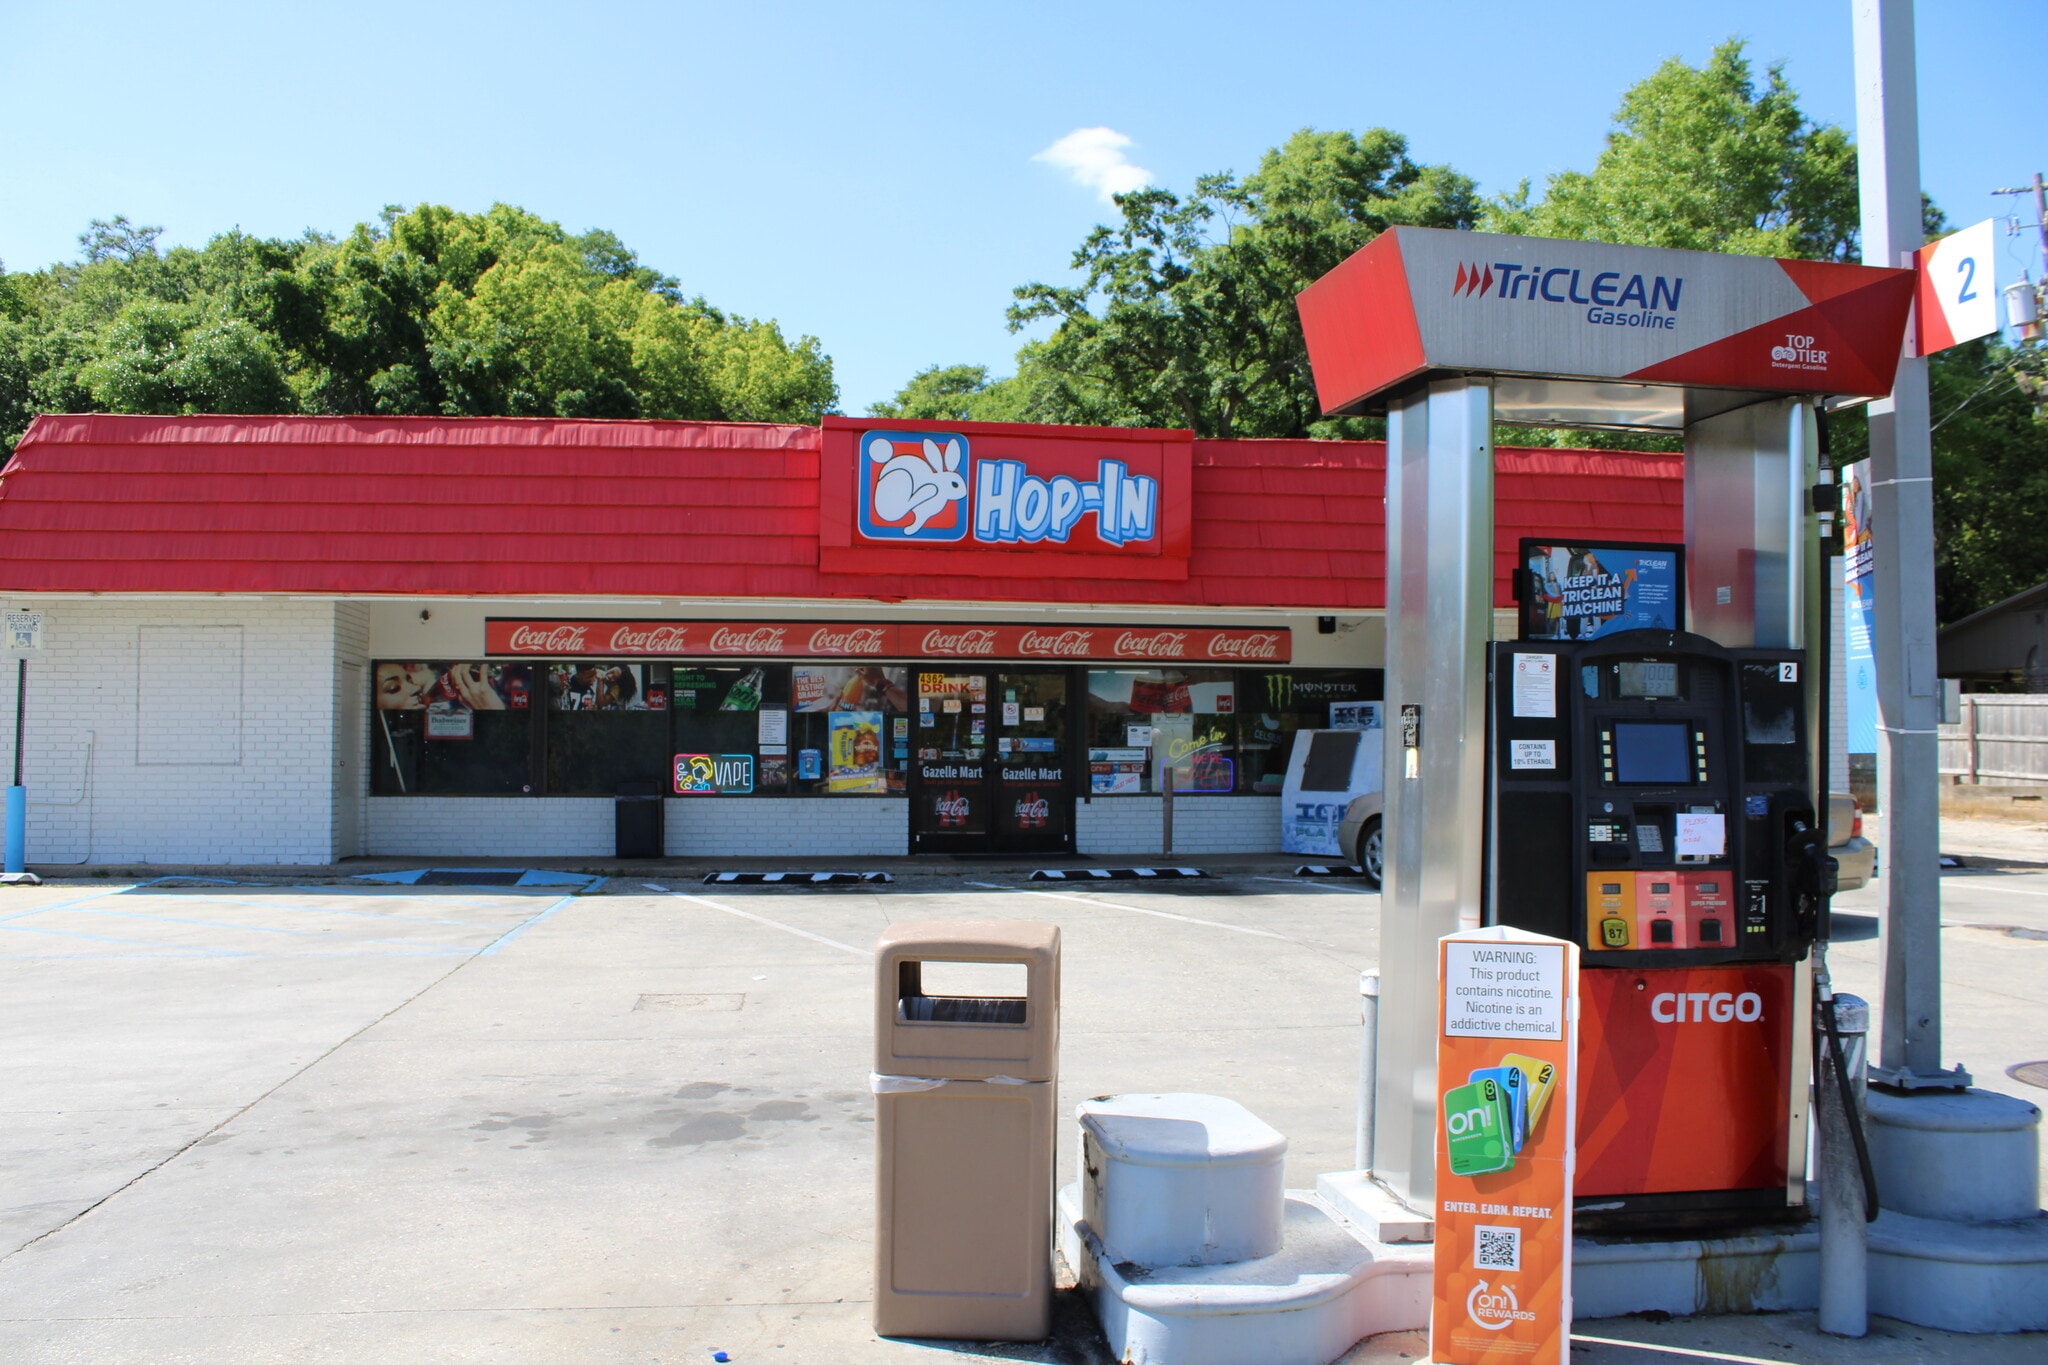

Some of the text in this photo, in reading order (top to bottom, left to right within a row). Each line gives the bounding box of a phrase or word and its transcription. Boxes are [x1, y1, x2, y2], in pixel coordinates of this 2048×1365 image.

[1494, 263, 1683, 311] TriCLEAN
[1958, 257, 1977, 304] 2
[1587, 307, 1676, 329] Gasoline
[1785, 334, 1815, 348] TOP
[1797, 349, 1827, 363] TIER
[1771, 361, 1827, 371] Detergent Gasoline
[1563, 572, 1621, 590] KEEP IT A
[1562, 586, 1621, 603] TRICLEAN
[1562, 600, 1623, 617] MACHINE
[7, 614, 41, 623] RESERVED
[10, 623, 39, 632] PARKING
[510, 625, 589, 651] Coca-Cola
[609, 626, 689, 652] Coca-Cola
[709, 626, 788, 652] Coca-Cola
[808, 627, 887, 653] Coca-Cola
[921, 628, 998, 654] Coca-Cola
[1018, 630, 1094, 656] Coca-Cola
[1114, 631, 1188, 657] Coca-Cola
[1207, 633, 1281, 659] Coca-Cola
[920, 674, 944, 684] 4362
[1785, 665, 1792, 680] 2
[797, 683, 825, 692] TASTING
[1293, 682, 1357, 693] MONSTER
[1169, 726, 1226, 759] Come in
[1527, 758, 1552, 766] ETHANOL
[713, 761, 750, 786] VAPE
[922, 765, 983, 779] Gazelle Mart
[1002, 767, 1062, 780] Gazelle Mart
[1608, 928, 1623, 939] 87
[1473, 951, 1537, 965] WARNING:
[1470, 967, 1541, 982] This product
[1456, 985, 1554, 999] contains nicotine.
[1466, 1001, 1542, 1016] Nicotine is an
[1651, 992, 1762, 1023] CITGO
[1451, 1018, 1557, 1033] addictive chemical.
[1510, 1068, 1519, 1082] 4
[1540, 1065, 1552, 1079] 2
[1485, 1080, 1495, 1096] 8
[1448, 1104, 1492, 1135] on!
[1444, 1201, 1552, 1219] ENTER. EARN. REPEAT.
[1478, 1294, 1507, 1309] on!
[1477, 1308, 1536, 1321] REWARDS
